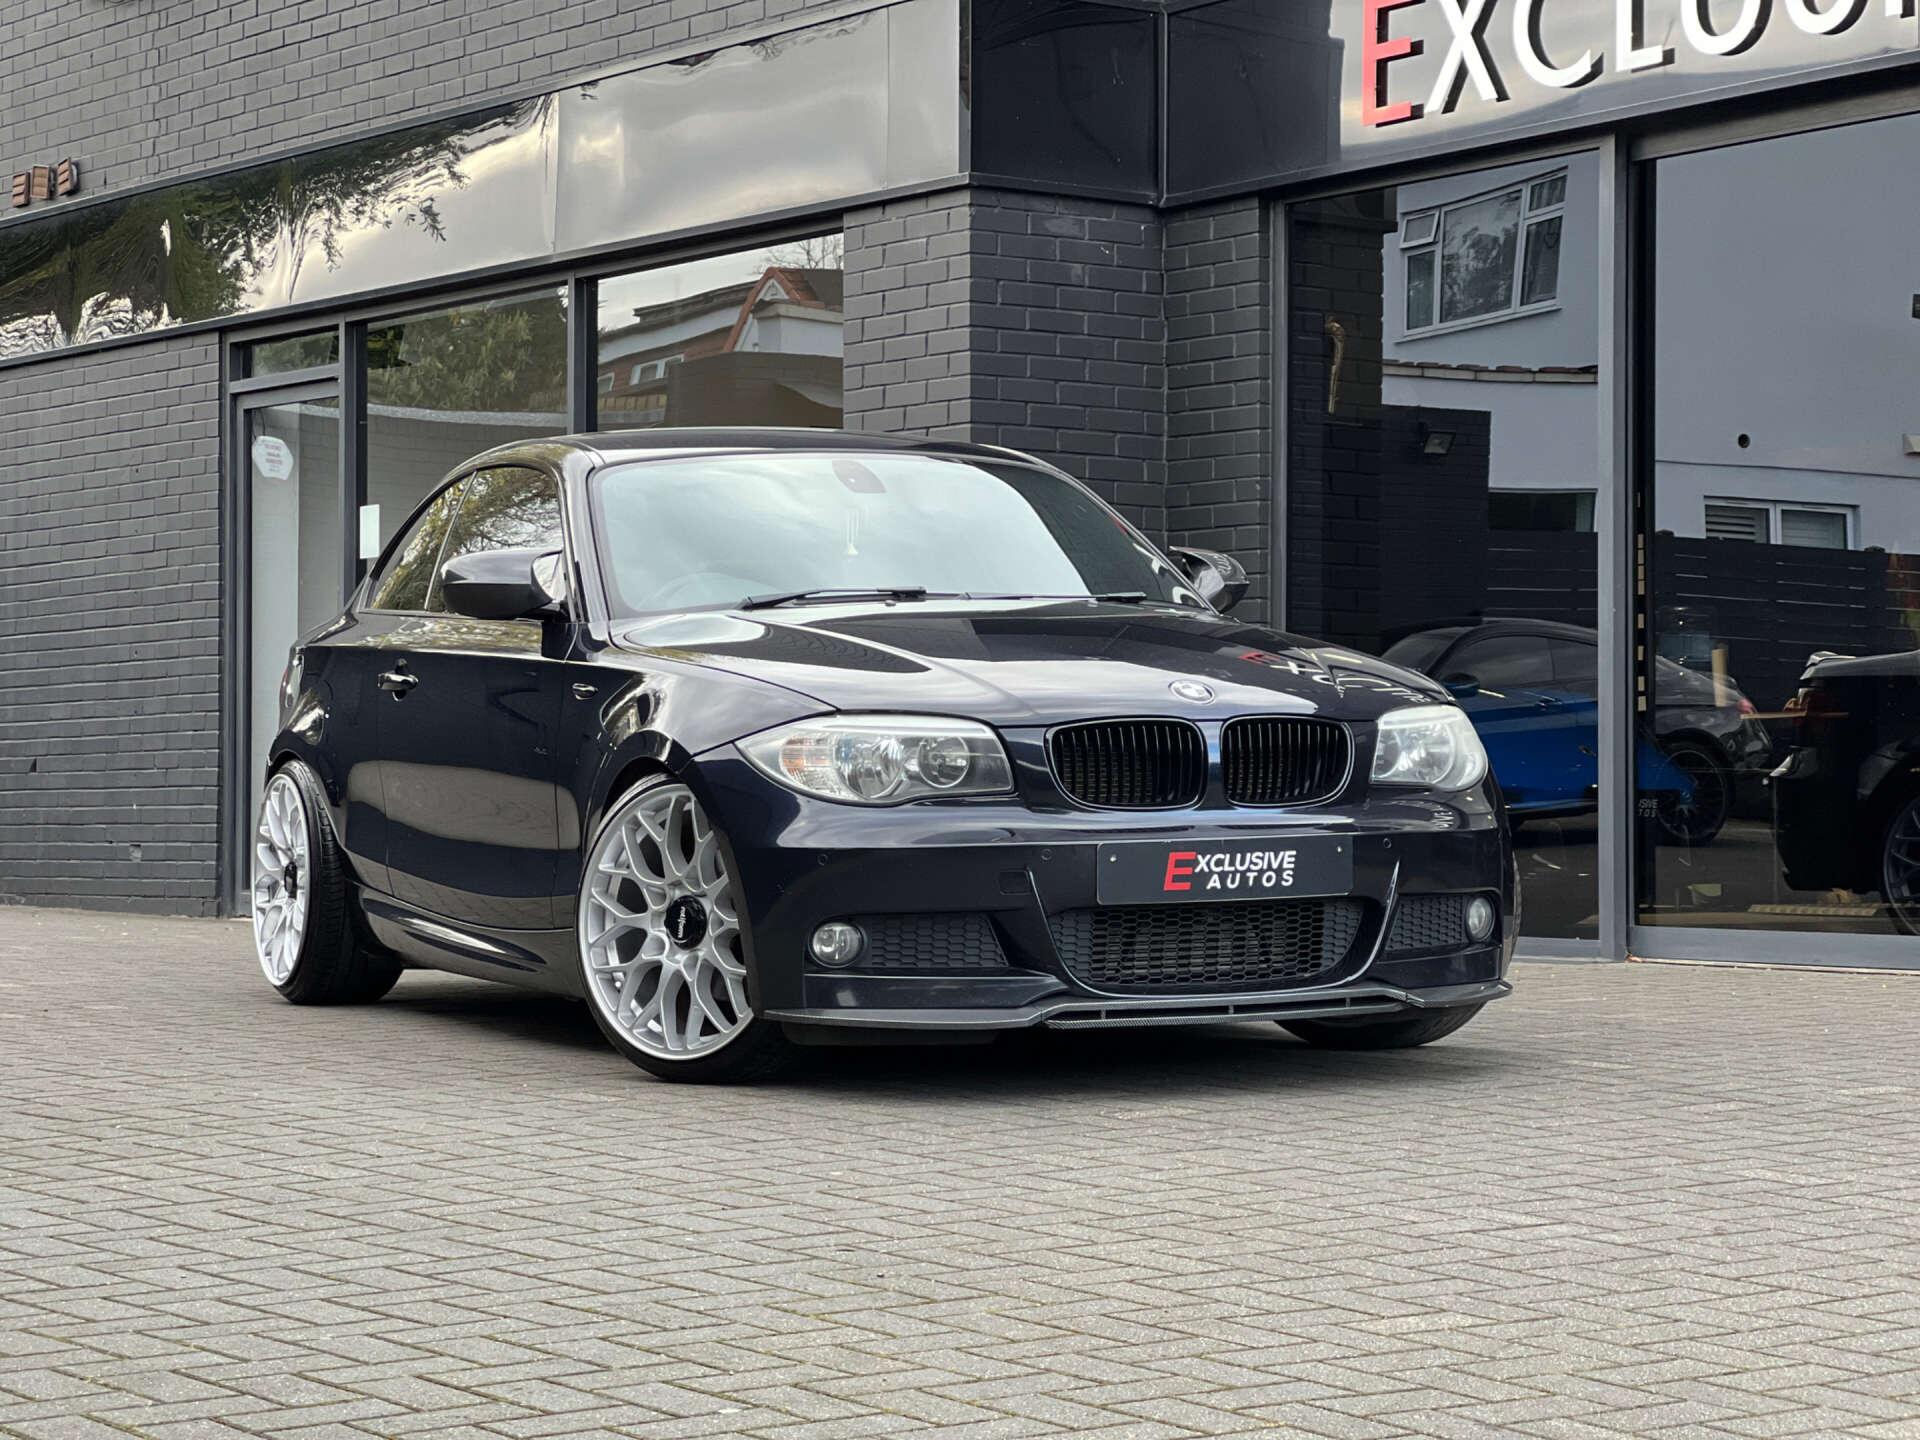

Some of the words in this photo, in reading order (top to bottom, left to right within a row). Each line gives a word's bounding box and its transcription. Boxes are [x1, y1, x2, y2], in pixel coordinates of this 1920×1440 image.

[1362, 0, 1908, 126] EXCL
[1163, 850, 1297, 891] EXCLUSIVE
[1206, 870, 1294, 890] AUTOS
